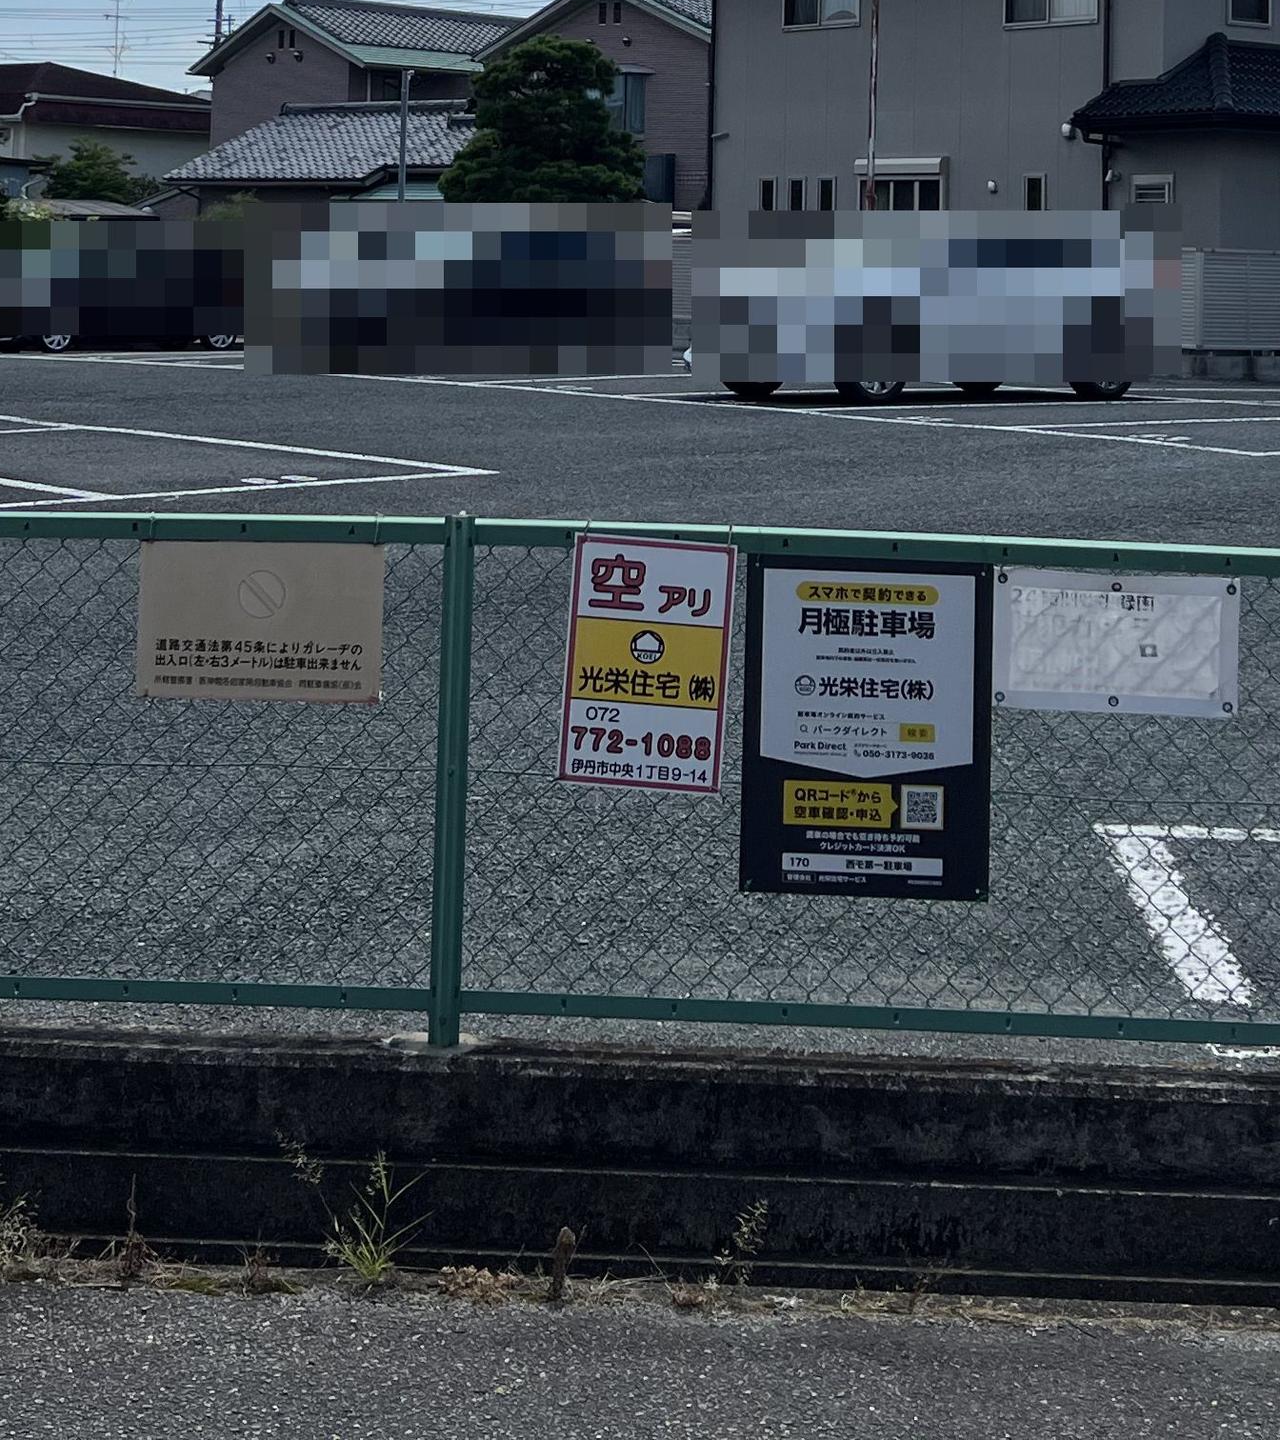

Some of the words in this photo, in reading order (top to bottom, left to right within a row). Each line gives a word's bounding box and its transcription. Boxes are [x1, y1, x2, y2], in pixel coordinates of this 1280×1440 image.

[588, 553, 647, 612] 空
[657, 584, 712, 618] アリ
[808, 585, 928, 603] スマホで契約できる
[797, 606, 937, 640] 月極駐車場
[578, 665, 681, 700] 光栄住宅
[818, 676, 935, 702] 光栄住宅(株)
[585, 706, 620, 723] 072
[571, 725, 712, 761] 772-1088
[812, 724, 888, 737] パークダイレクト
[793, 740, 817, 750] Park
[817, 741, 847, 752] Direct
[571, 758, 708, 784] 伊丹市中央1丁目9-14
[788, 856, 810, 868] 170
